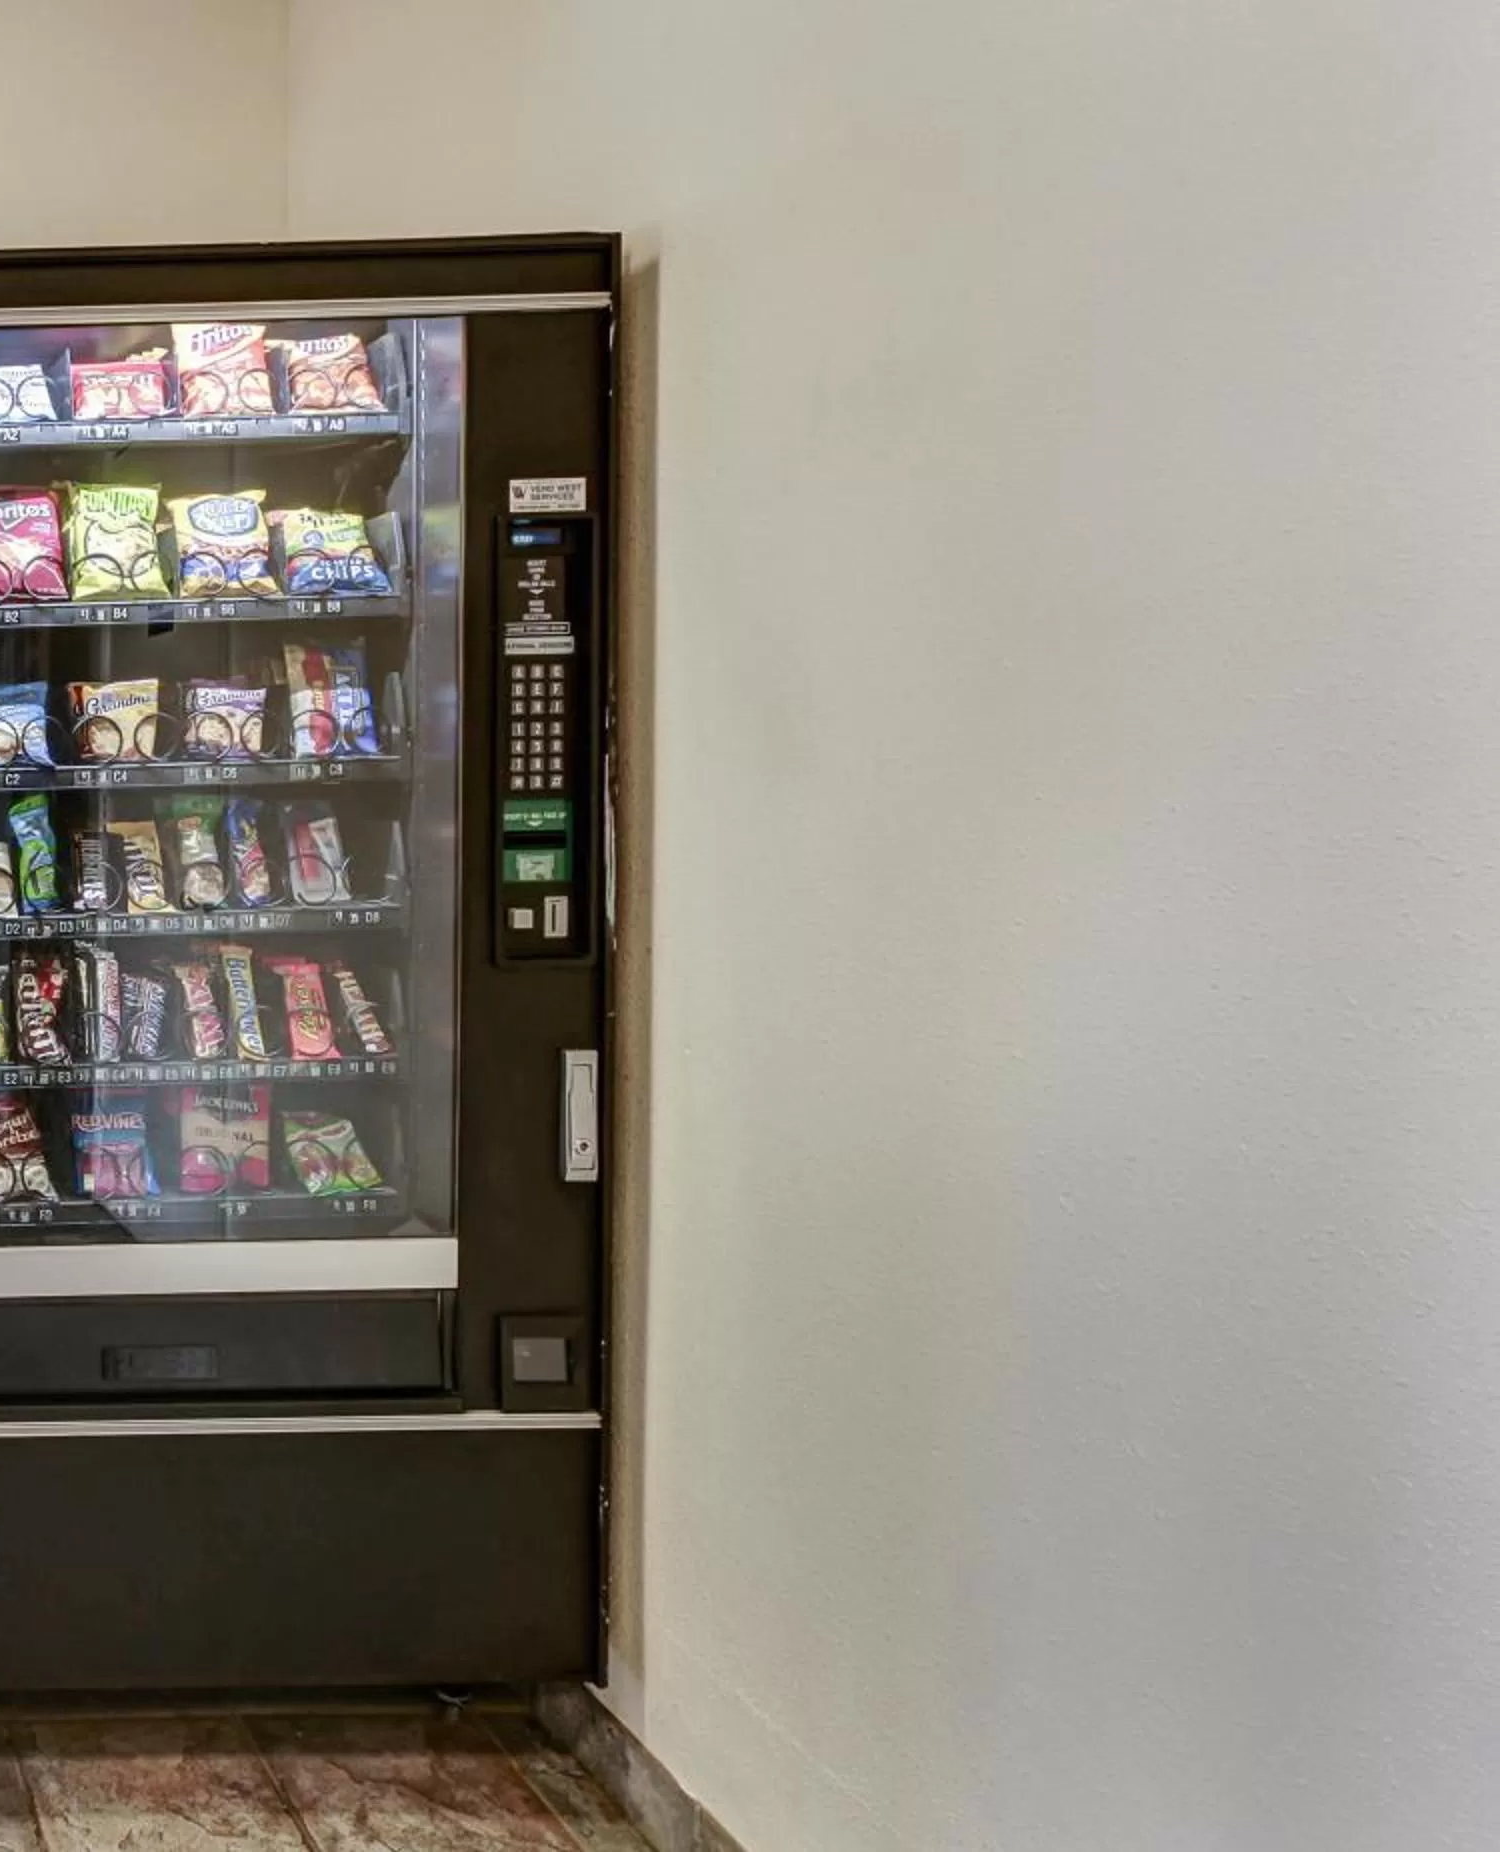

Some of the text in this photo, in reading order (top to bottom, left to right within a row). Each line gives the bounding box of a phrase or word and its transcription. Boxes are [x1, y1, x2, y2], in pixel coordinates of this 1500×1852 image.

[311, 565, 375, 581] CHIPS
[4, 611, 19, 623] B2
[113, 608, 128, 619] B4
[5, 773, 20, 785] C2
[113, 771, 128, 782] C4
[59, 921, 74, 932] D3
[4, 1072, 18, 1084] E2
[58, 1071, 71, 1083] E3
